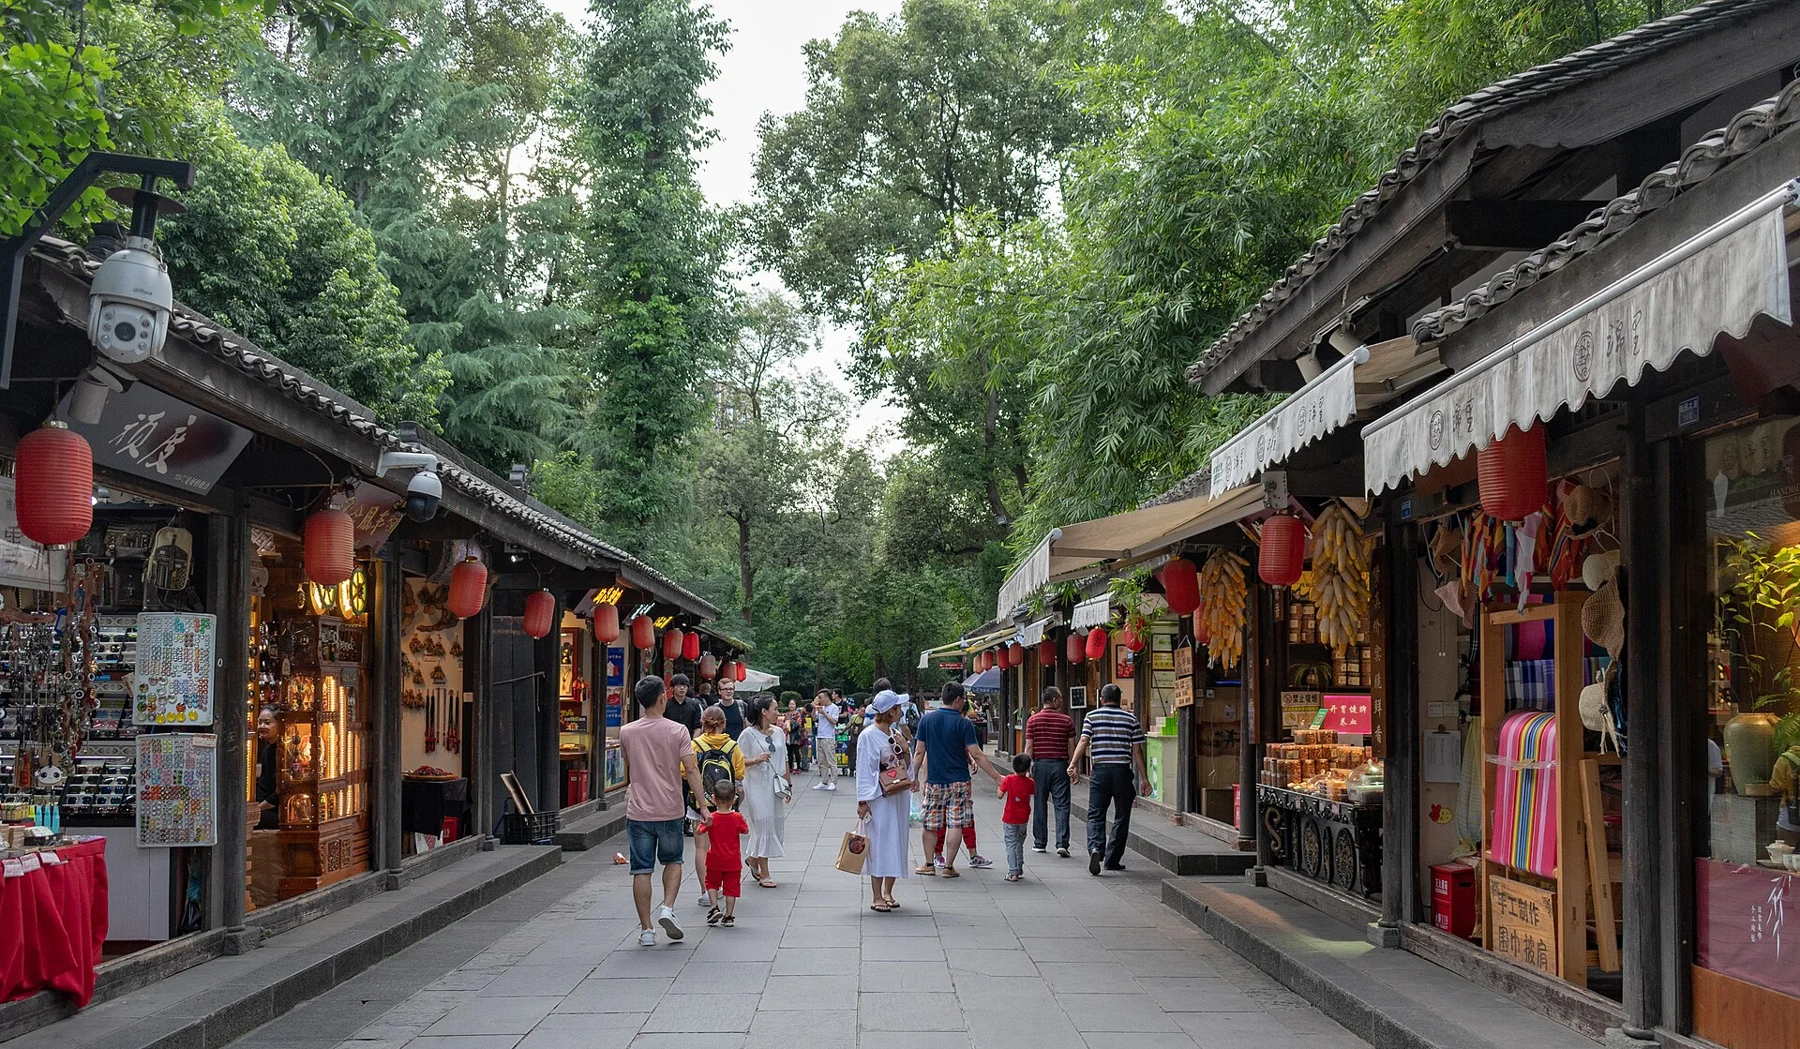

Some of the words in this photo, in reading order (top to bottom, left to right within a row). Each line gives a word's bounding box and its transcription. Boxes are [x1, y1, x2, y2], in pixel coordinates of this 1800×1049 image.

[1498, 891, 1541, 927] 手工制作
[1499, 925, 1548, 972] 围巾披肩
